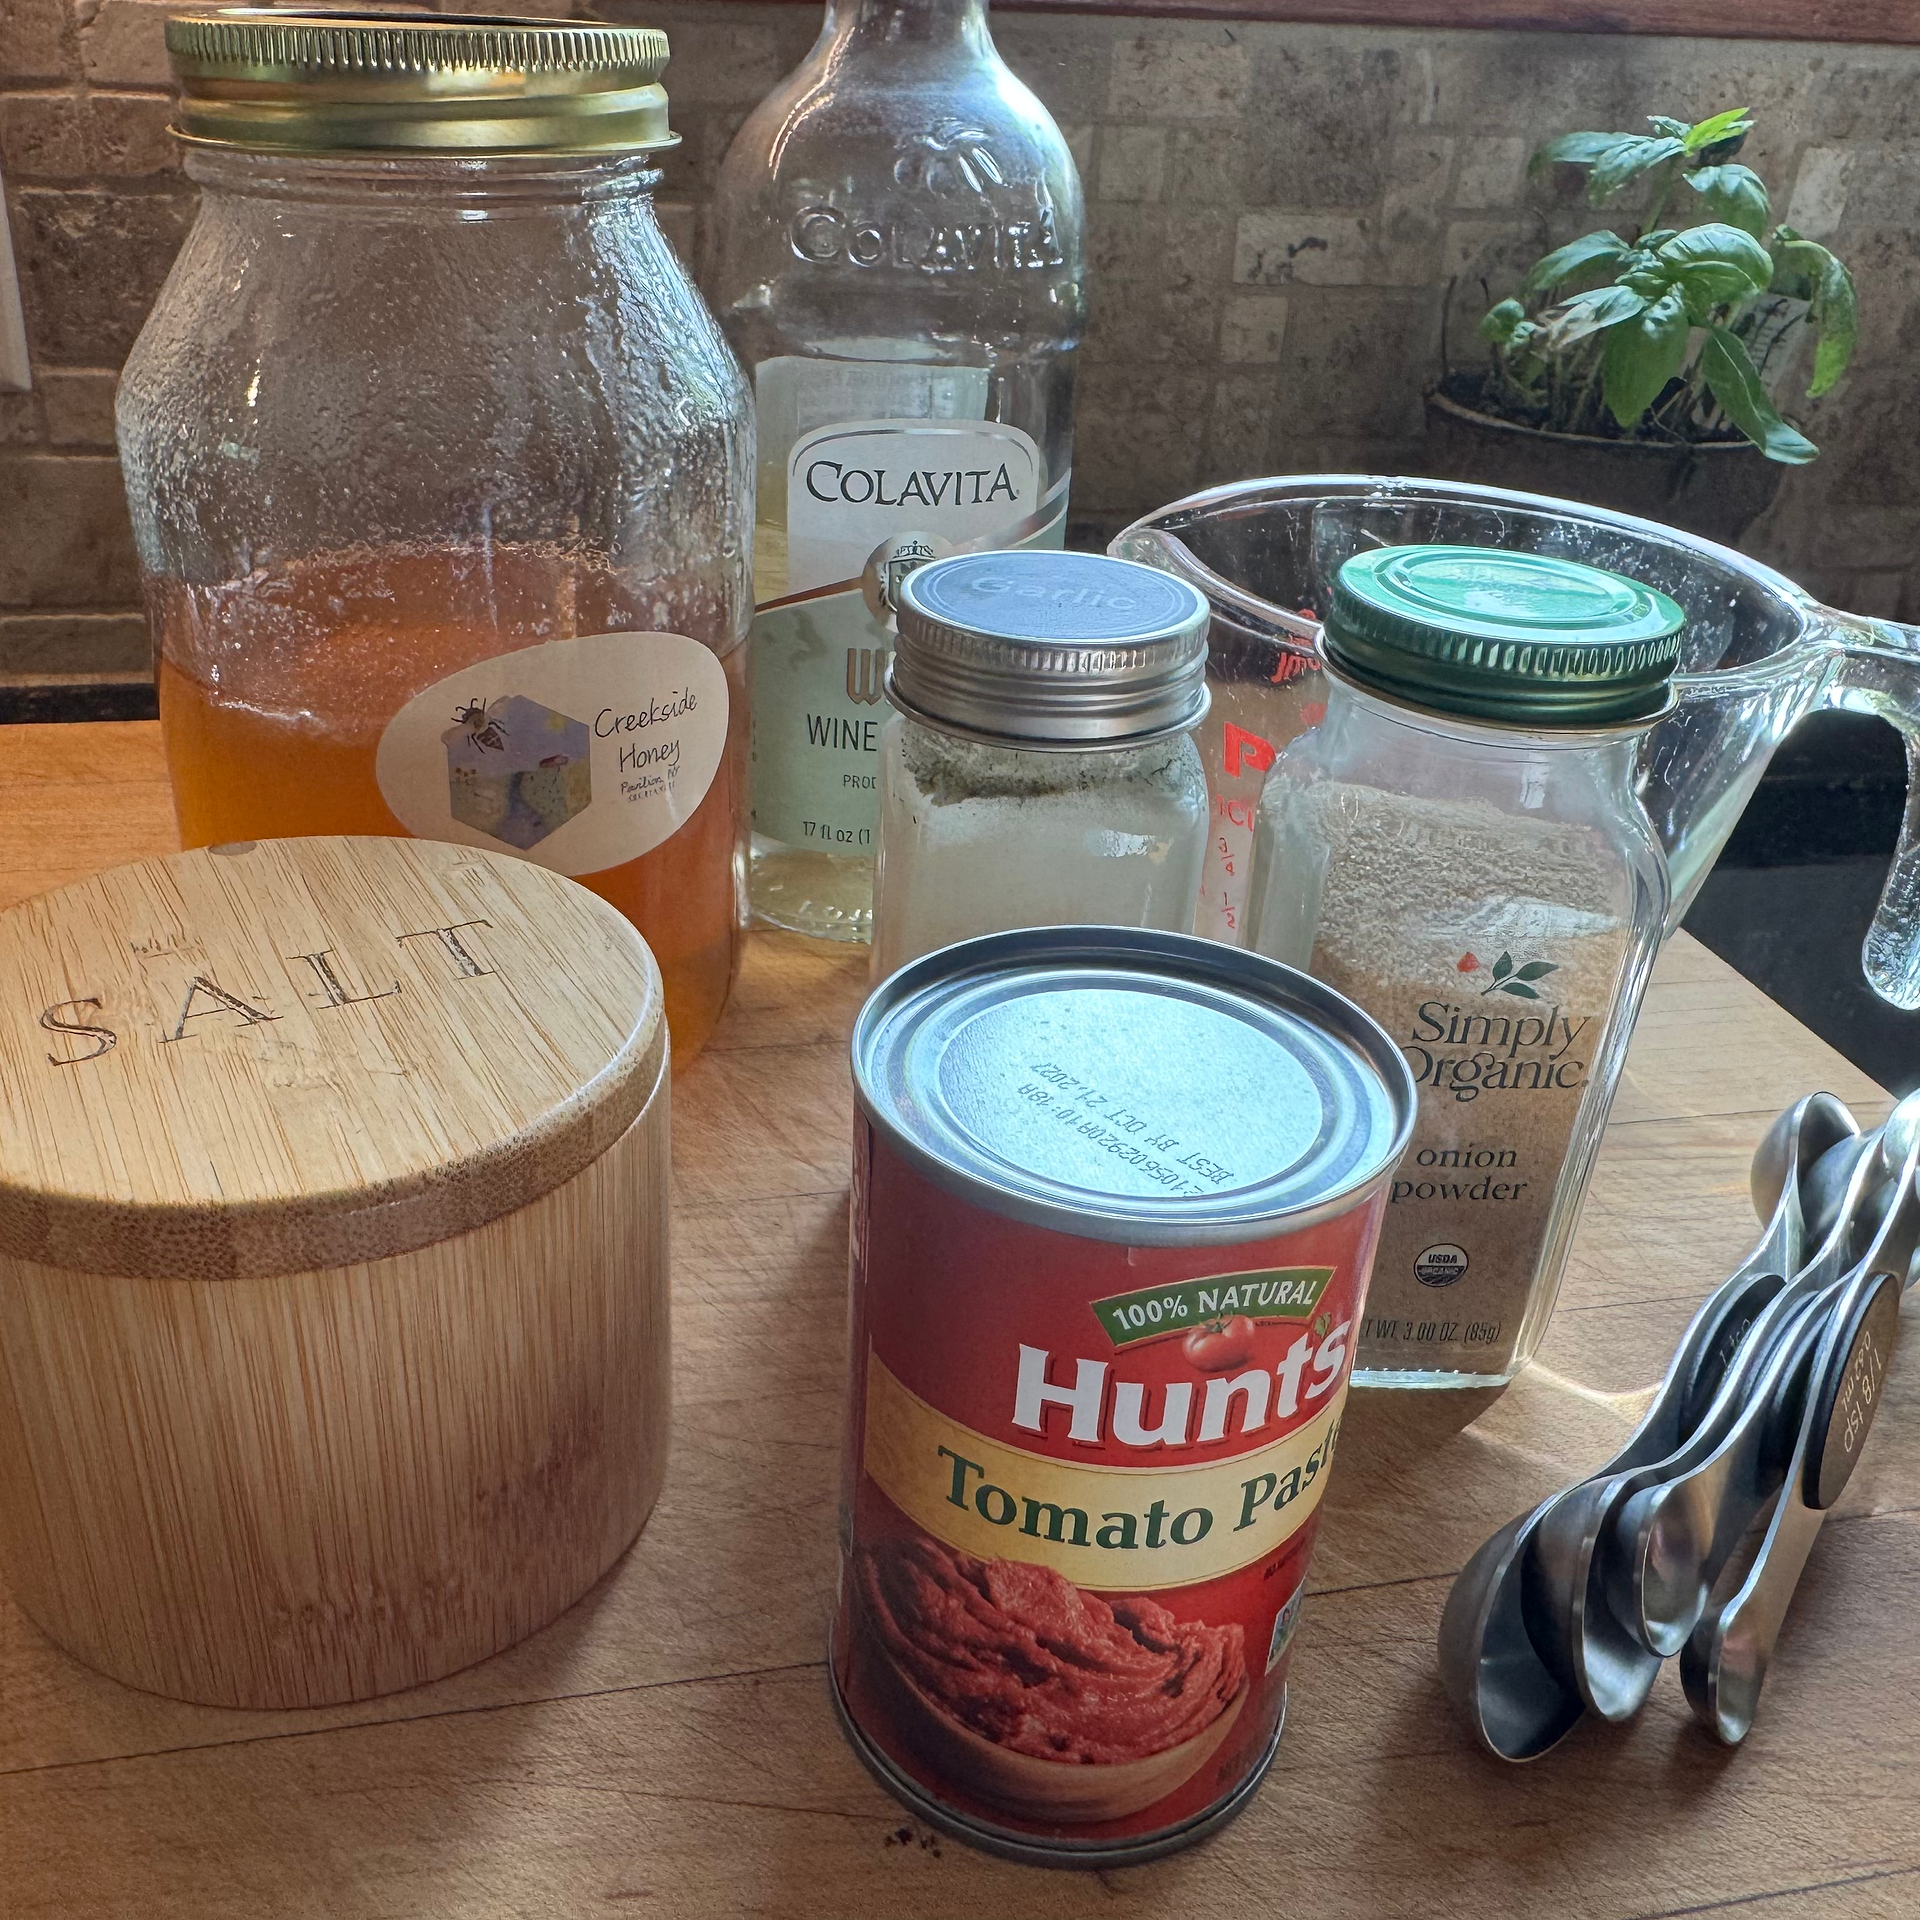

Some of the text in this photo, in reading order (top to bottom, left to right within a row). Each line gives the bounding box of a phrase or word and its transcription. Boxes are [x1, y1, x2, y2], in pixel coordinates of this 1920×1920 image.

[806, 460, 1017, 506] COLAVITA
[971, 576, 1136, 612] Garlic
[594, 686, 698, 739] Creekside
[807, 713, 878, 751] WINE
[619, 739, 681, 774] Honey
[39, 918, 494, 1067] SALT
[1412, 1001, 1592, 1060] Simply
[1401, 1046, 1585, 1102] Organic
[1103, 1108, 1148, 1136] OCT
[1143, 1133, 1180, 1152] BY
[1416, 1142, 1517, 1168] onion
[1175, 1152, 1235, 1185] BEST
[1390, 1176, 1528, 1204] powder
[1427, 1253, 1458, 1264] USDA
[1112, 1280, 1319, 1330] 100% NATURAL
[1403, 1321, 1437, 1341] 3.00
[1464, 1321, 1502, 1345] (85g)
[938, 1418, 1342, 1549] Tomato Past
